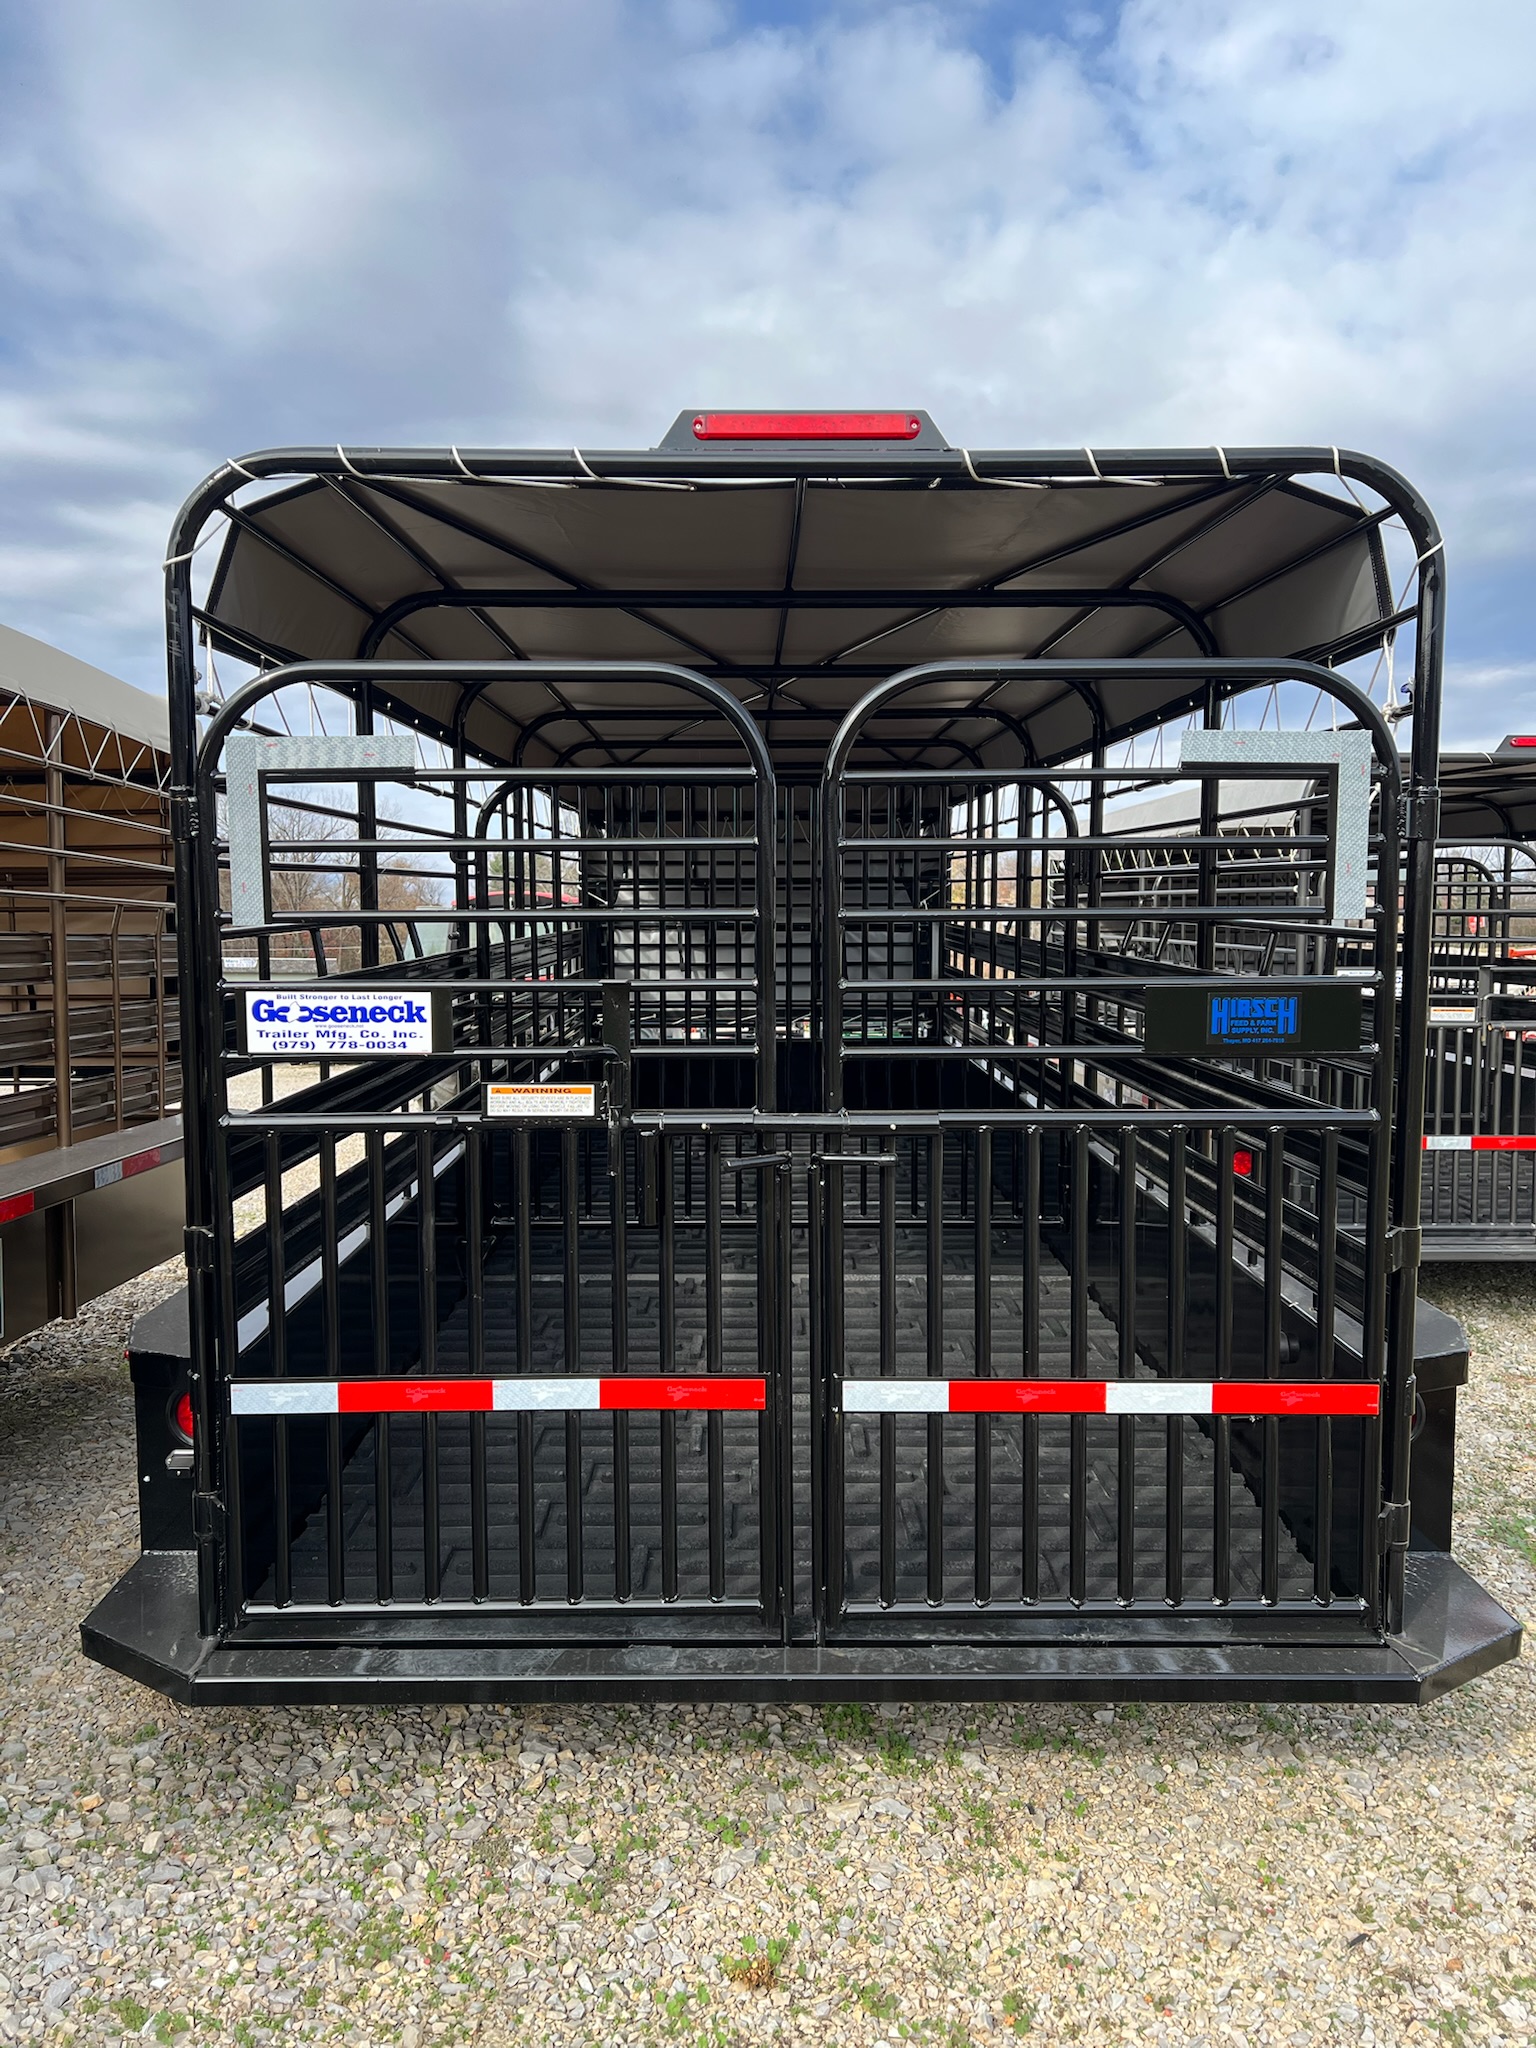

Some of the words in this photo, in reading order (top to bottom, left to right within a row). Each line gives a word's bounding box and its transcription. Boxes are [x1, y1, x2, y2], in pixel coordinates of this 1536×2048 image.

[252, 999, 427, 1023] Gooseneck
[1211, 996, 1298, 1034] HIRSCH
[256, 1030, 309, 1038] Trailer
[316, 1030, 353, 1040] Mfg.
[360, 1030, 386, 1038] Co.
[393, 1030, 424, 1038] Inc.
[272, 1041, 316, 1050] (979)
[326, 1041, 408, 1050] 778-0034
